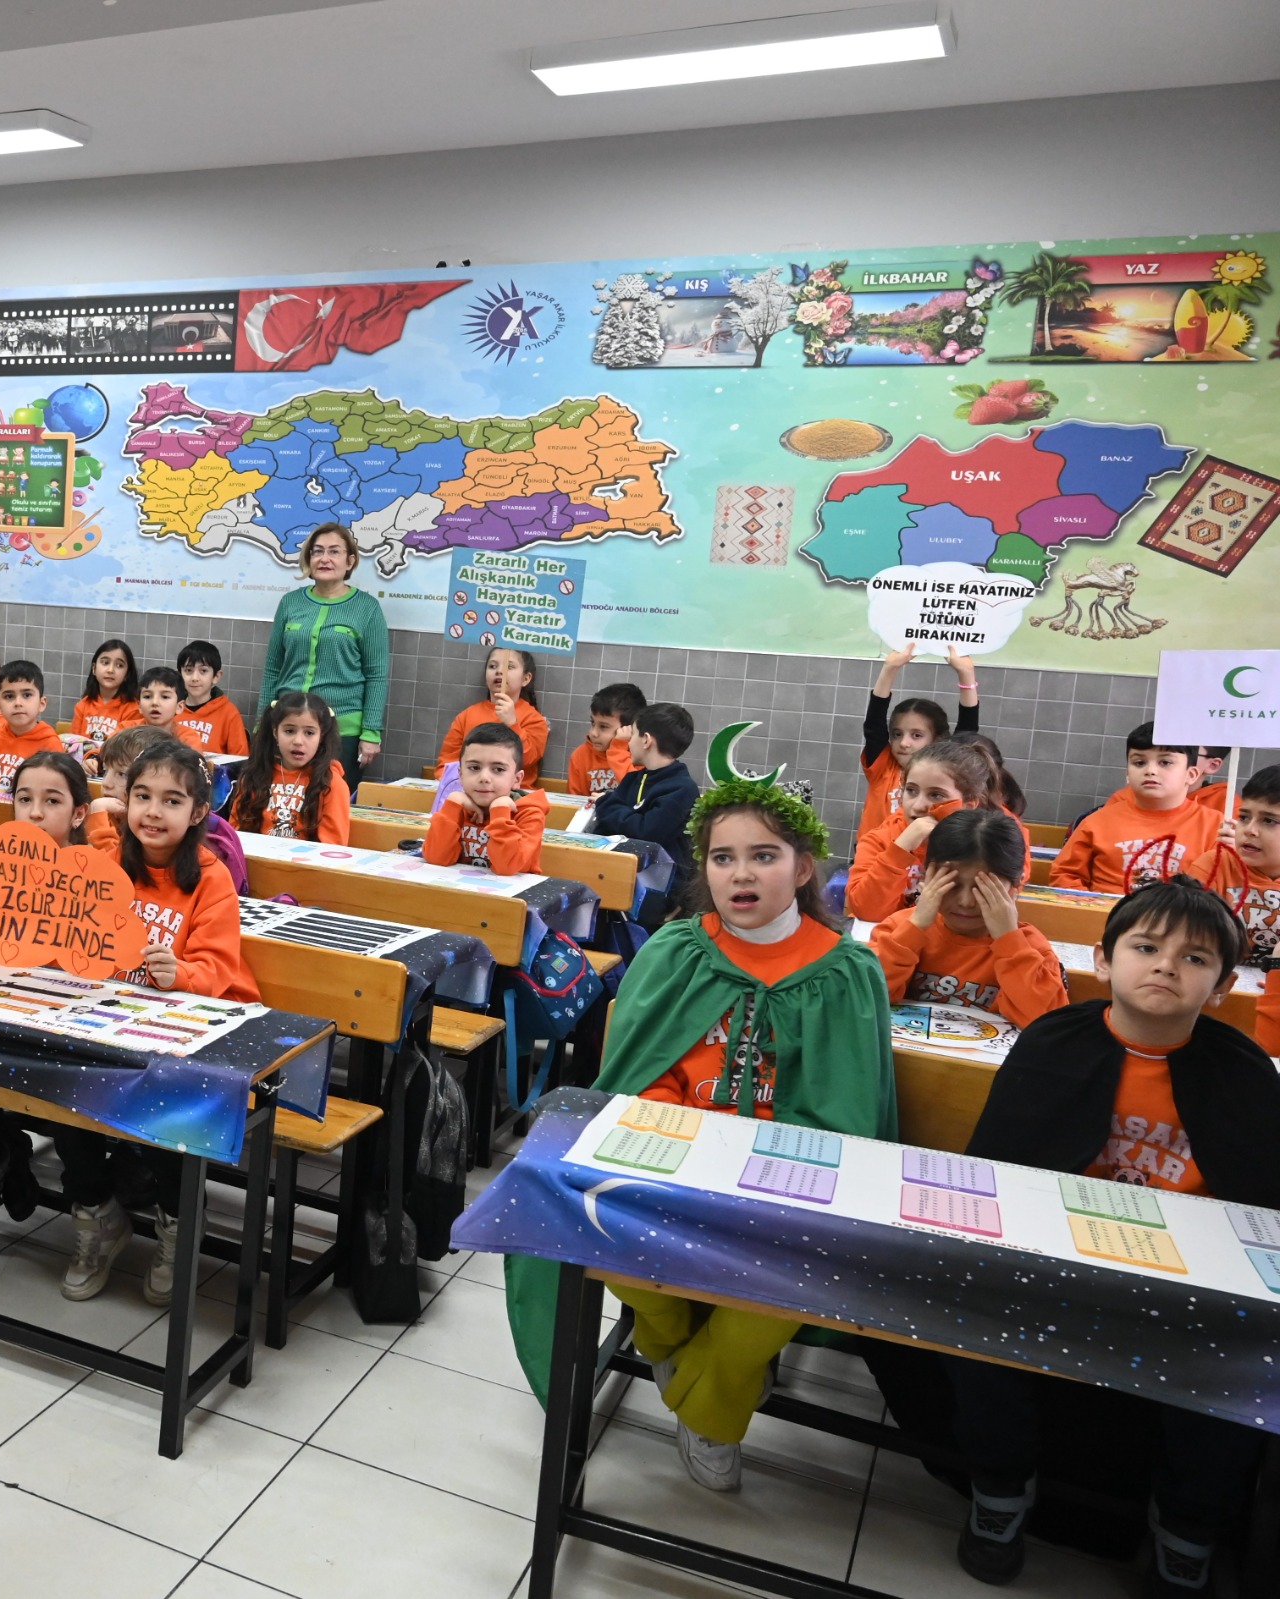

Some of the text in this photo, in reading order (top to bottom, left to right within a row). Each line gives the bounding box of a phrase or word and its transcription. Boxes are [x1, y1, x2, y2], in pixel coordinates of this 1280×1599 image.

[1125, 263, 1160, 275] YAZ
[685, 279, 709, 292] KIŞ
[863, 270, 948, 286] İLKBAHAR
[525, 290, 555, 304] YAŞAR
[553, 303, 566, 322] AKAR
[950, 470, 1001, 484] UŞAK
[1053, 515, 1087, 524] SİVASLI
[844, 528, 866, 536] EŞME
[474, 552, 565, 574] Zararlı Her
[992, 558, 1041, 566] KARAHALLI
[459, 567, 536, 588] Alışkanlık
[872, 577, 1035, 599] ÖNEMLİ İSE HAYATINIZ
[389, 592, 448, 602] KARADENİZ BÖLGES
[477, 587, 557, 609] Hayatında
[922, 596, 976, 611] LÜTFEN
[581, 604, 679, 615] NEYDOĞU ANADOLU BÖLGESİ
[506, 609, 562, 627] Yaratır
[919, 612, 975, 627] TÜTÜNÜ
[503, 627, 571, 649] Karanlık
[905, 628, 985, 643] BIRAKINIZ!
[1208, 709, 1277, 719] YEŞİLAY
[45, 869, 115, 902] SEÇME
[32, 919, 116, 962] ELİNDE
